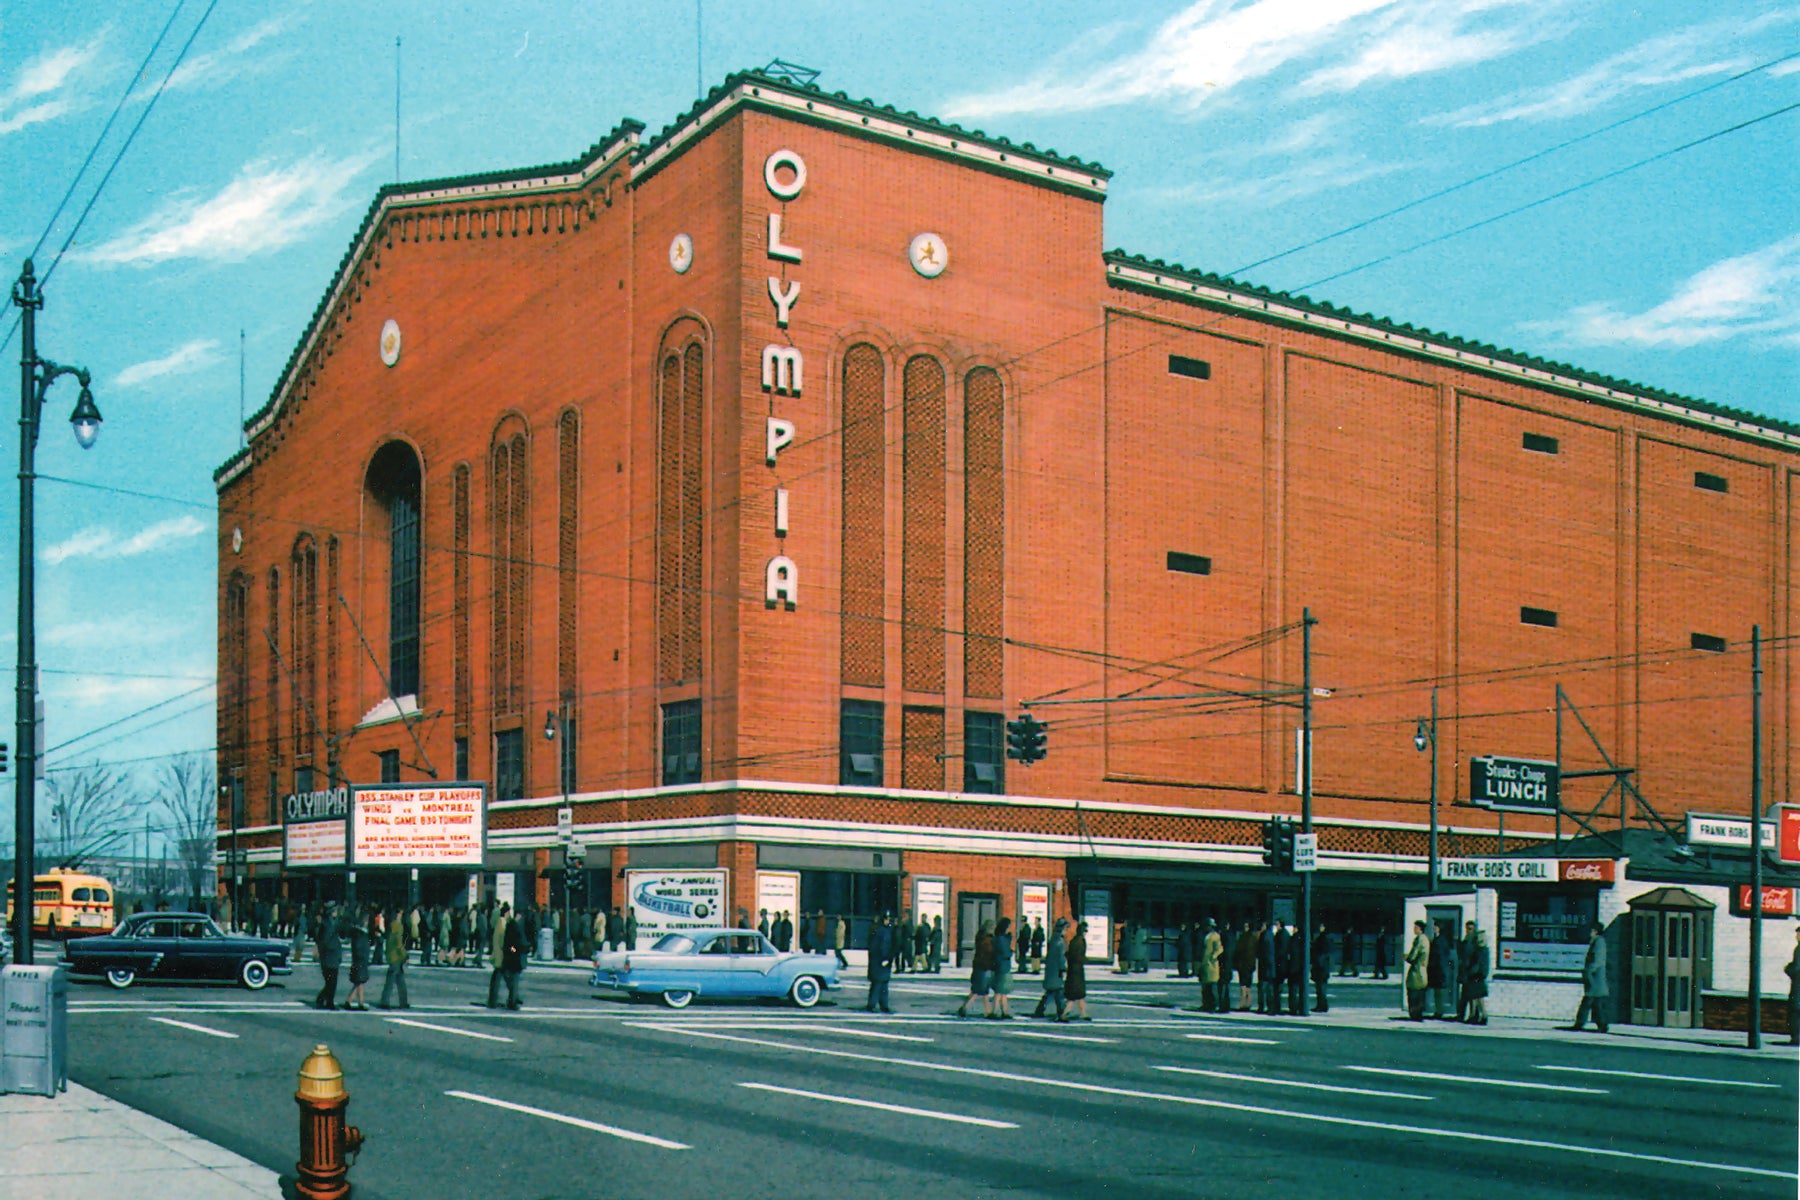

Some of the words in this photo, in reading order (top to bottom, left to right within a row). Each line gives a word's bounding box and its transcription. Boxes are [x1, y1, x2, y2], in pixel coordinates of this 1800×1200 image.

[762, 148, 807, 612] OLYMPIA
[380, 792, 414, 801] STANLEY
[419, 791, 435, 801] CUP
[439, 791, 481, 800] PLAYOFFS
[1486, 779, 1547, 802] LUNCH
[287, 787, 348, 819] OLYMPIA
[362, 804, 392, 814] WINGS
[422, 803, 475, 813] MONTREAL
[365, 816, 391, 825] FINAL
[394, 816, 417, 825] GAME
[439, 815, 473, 824] TONIGHT
[1700, 824, 1726, 837] FRANK
[1447, 861, 1512, 878] FRANK-BOB'S
[1518, 862, 1547, 878] GRILL
[655, 888, 682, 896] WORLD
[689, 888, 719, 896] SERIES
